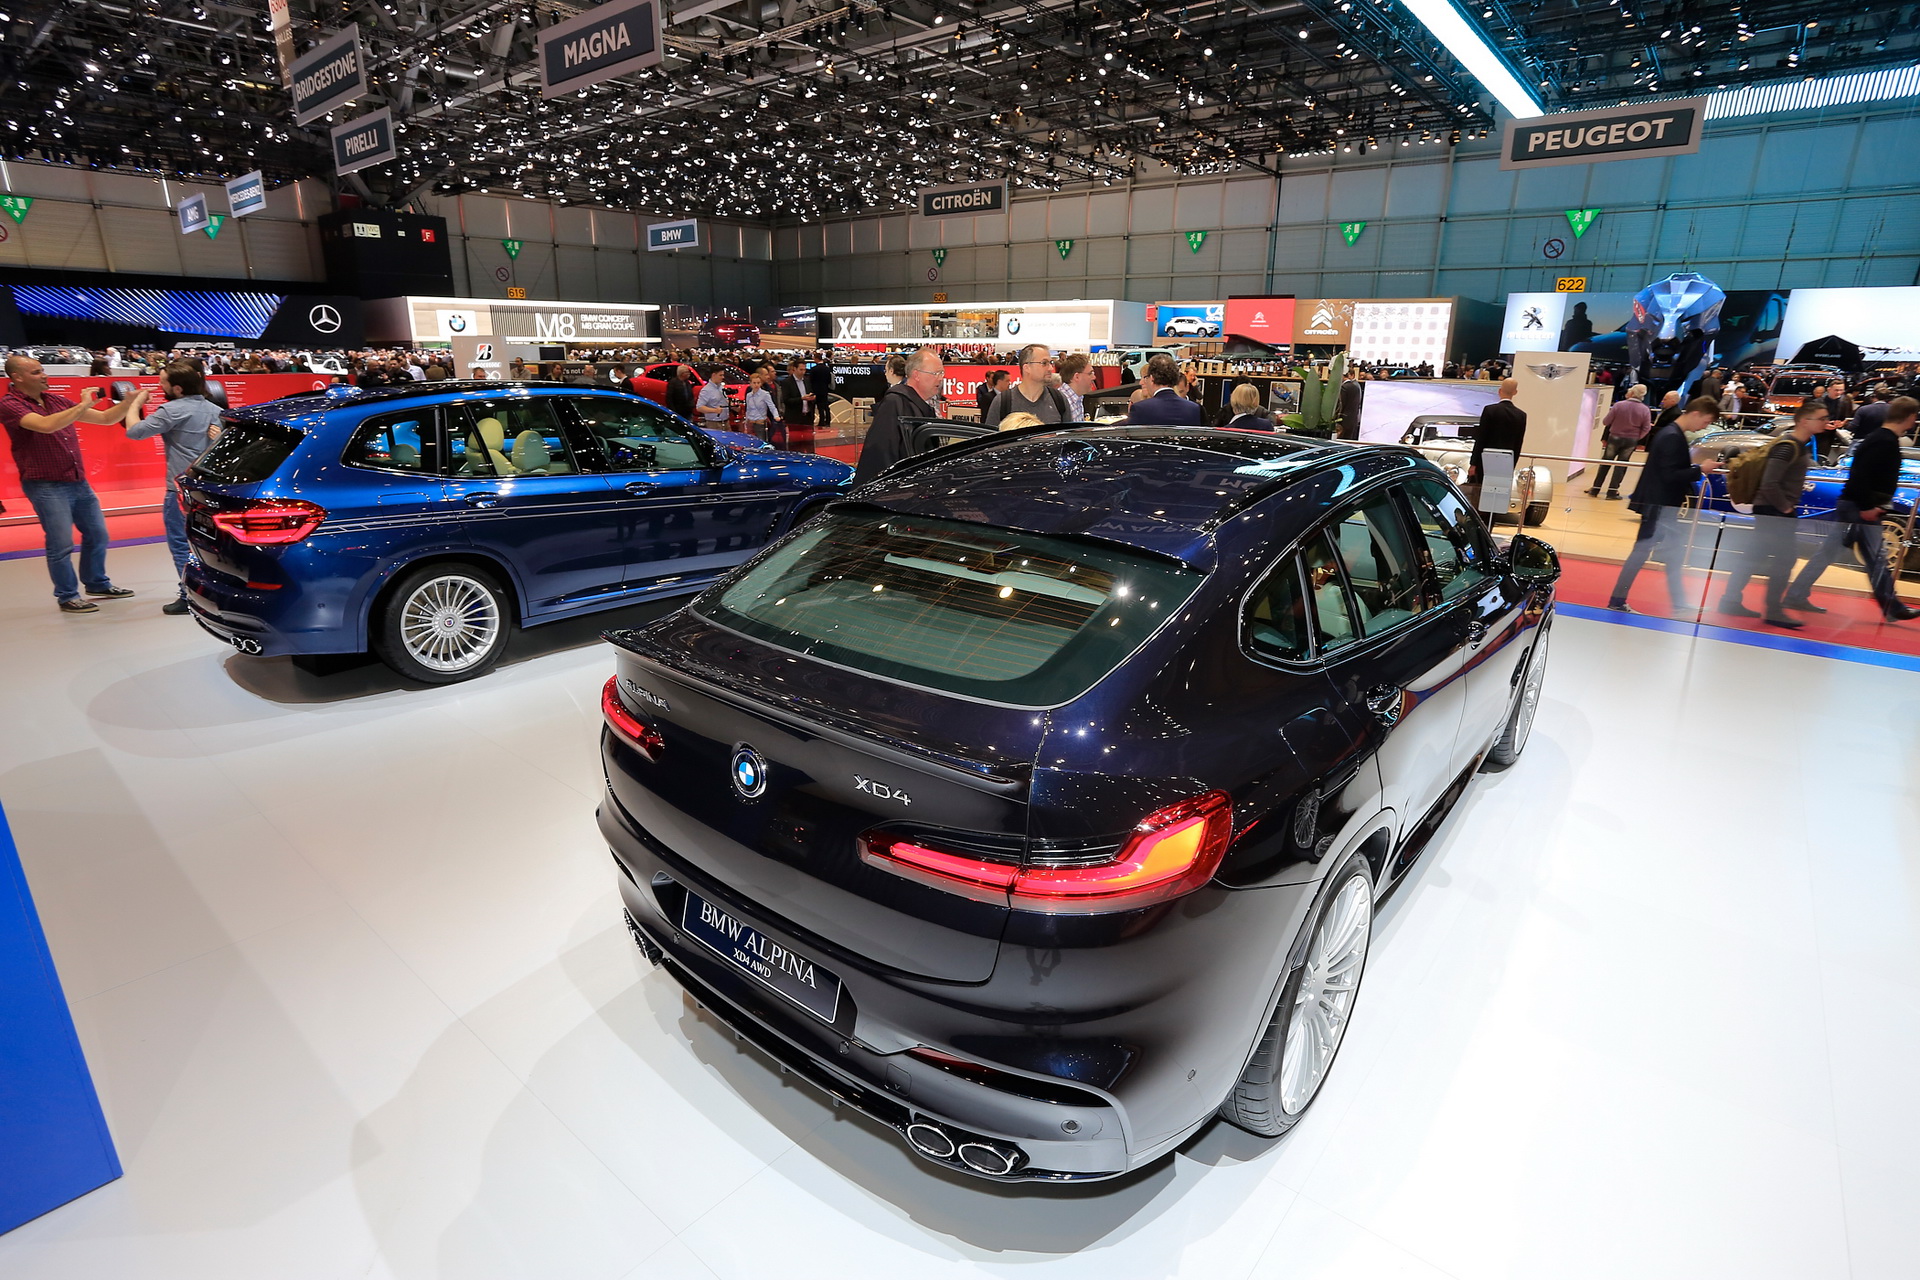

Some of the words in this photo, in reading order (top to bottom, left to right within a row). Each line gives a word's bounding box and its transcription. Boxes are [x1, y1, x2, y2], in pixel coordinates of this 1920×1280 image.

[563, 22, 631, 69] MAGNA
[295, 51, 357, 102] BRIDGESTONE
[344, 128, 379, 157] PIRELLI
[1527, 117, 1675, 153] PEUGEOT
[931, 188, 992, 210] CITROËN
[425, 232, 431, 240] F
[661, 229, 682, 242] BMW
[508, 288, 525, 298] 619
[1557, 279, 1584, 291] 622
[534, 312, 576, 338] M8
[580, 314, 597, 322] BMW
[598, 315, 630, 323] CONCEPT
[592, 322, 612, 331] GRAN
[837, 316, 863, 340] X4
[832, 367, 852, 375] SAVING
[852, 367, 871, 375] COSTS
[942, 378, 965, 396] It's
[853, 774, 912, 806] XD4
[700, 900, 745, 943] BMW
[743, 931, 817, 990] ALPINA
[733, 947, 752, 967] XD4
[750, 961, 772, 979] AWD
